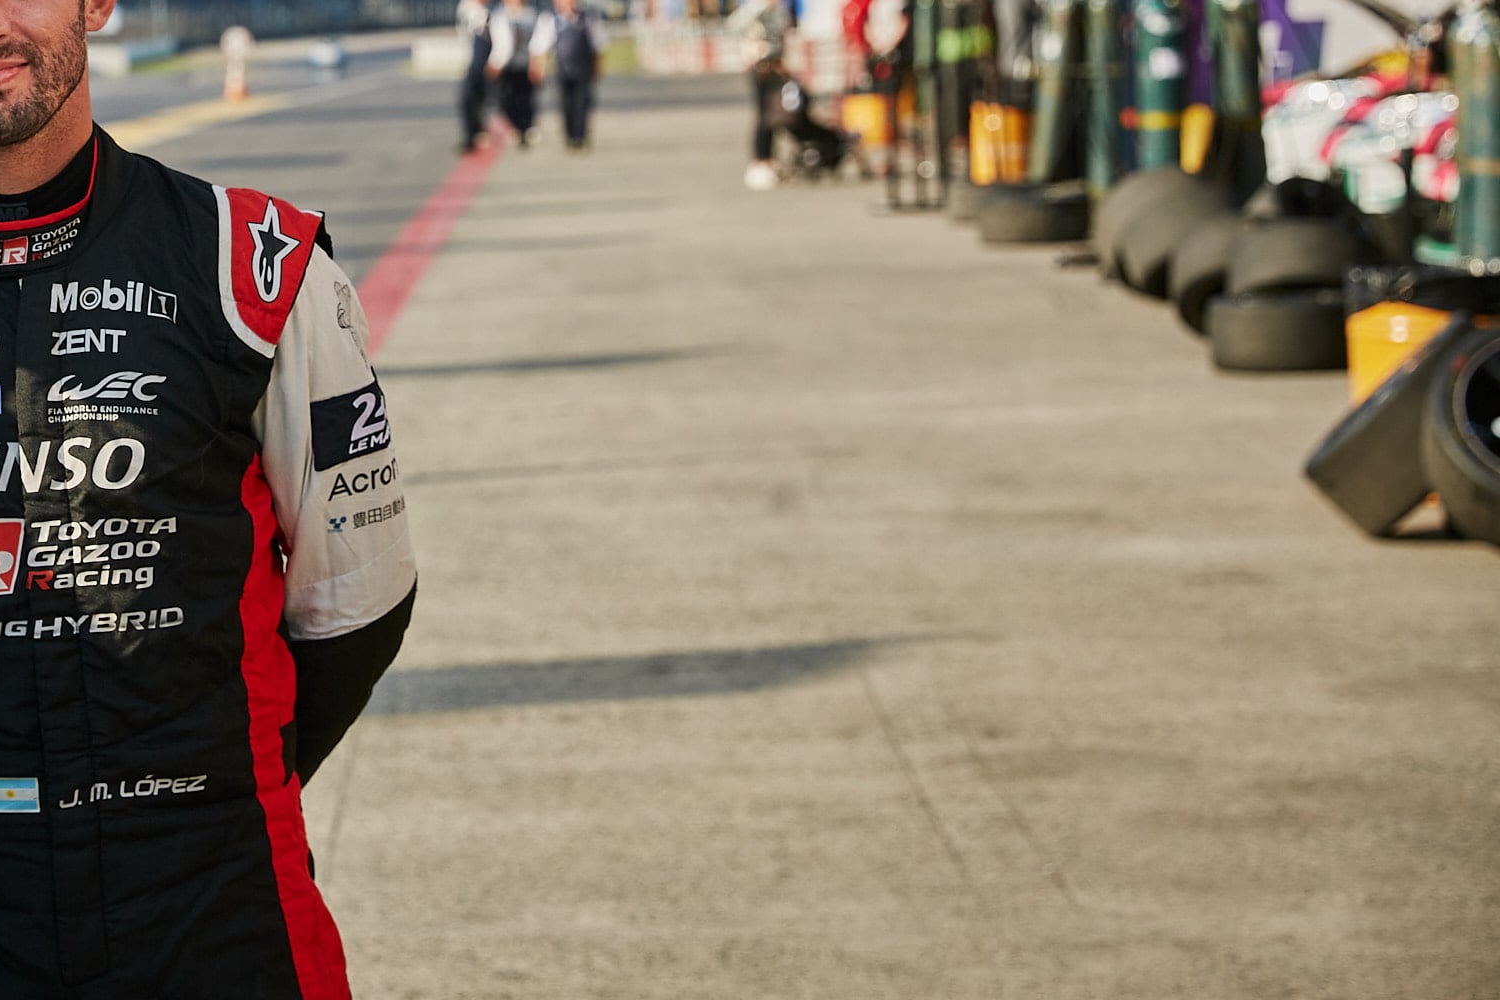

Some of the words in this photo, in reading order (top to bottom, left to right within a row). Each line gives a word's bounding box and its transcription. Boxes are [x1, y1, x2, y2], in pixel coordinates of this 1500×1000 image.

[31, 217, 81, 242] TOYOTA
[32, 228, 78, 252] GAZOO
[31, 241, 74, 262] Racin
[50, 279, 144, 314] Mobil
[51, 328, 127, 356] ZENT
[47, 371, 167, 402] WEC
[47, 407, 63, 416] FIA
[63, 404, 98, 415] WORLD
[100, 405, 159, 416] ENDURANCE
[47, 412, 119, 424] CHAMPIONSHIP
[348, 439, 368, 455] LE
[29, 517, 177, 543] TOYOTA
[27, 540, 161, 567] GAZOO
[26, 566, 155, 590] Racing
[59, 789, 82, 809] J.
[90, 782, 113, 802] M.
[120, 774, 207, 798] LÓPEZ
